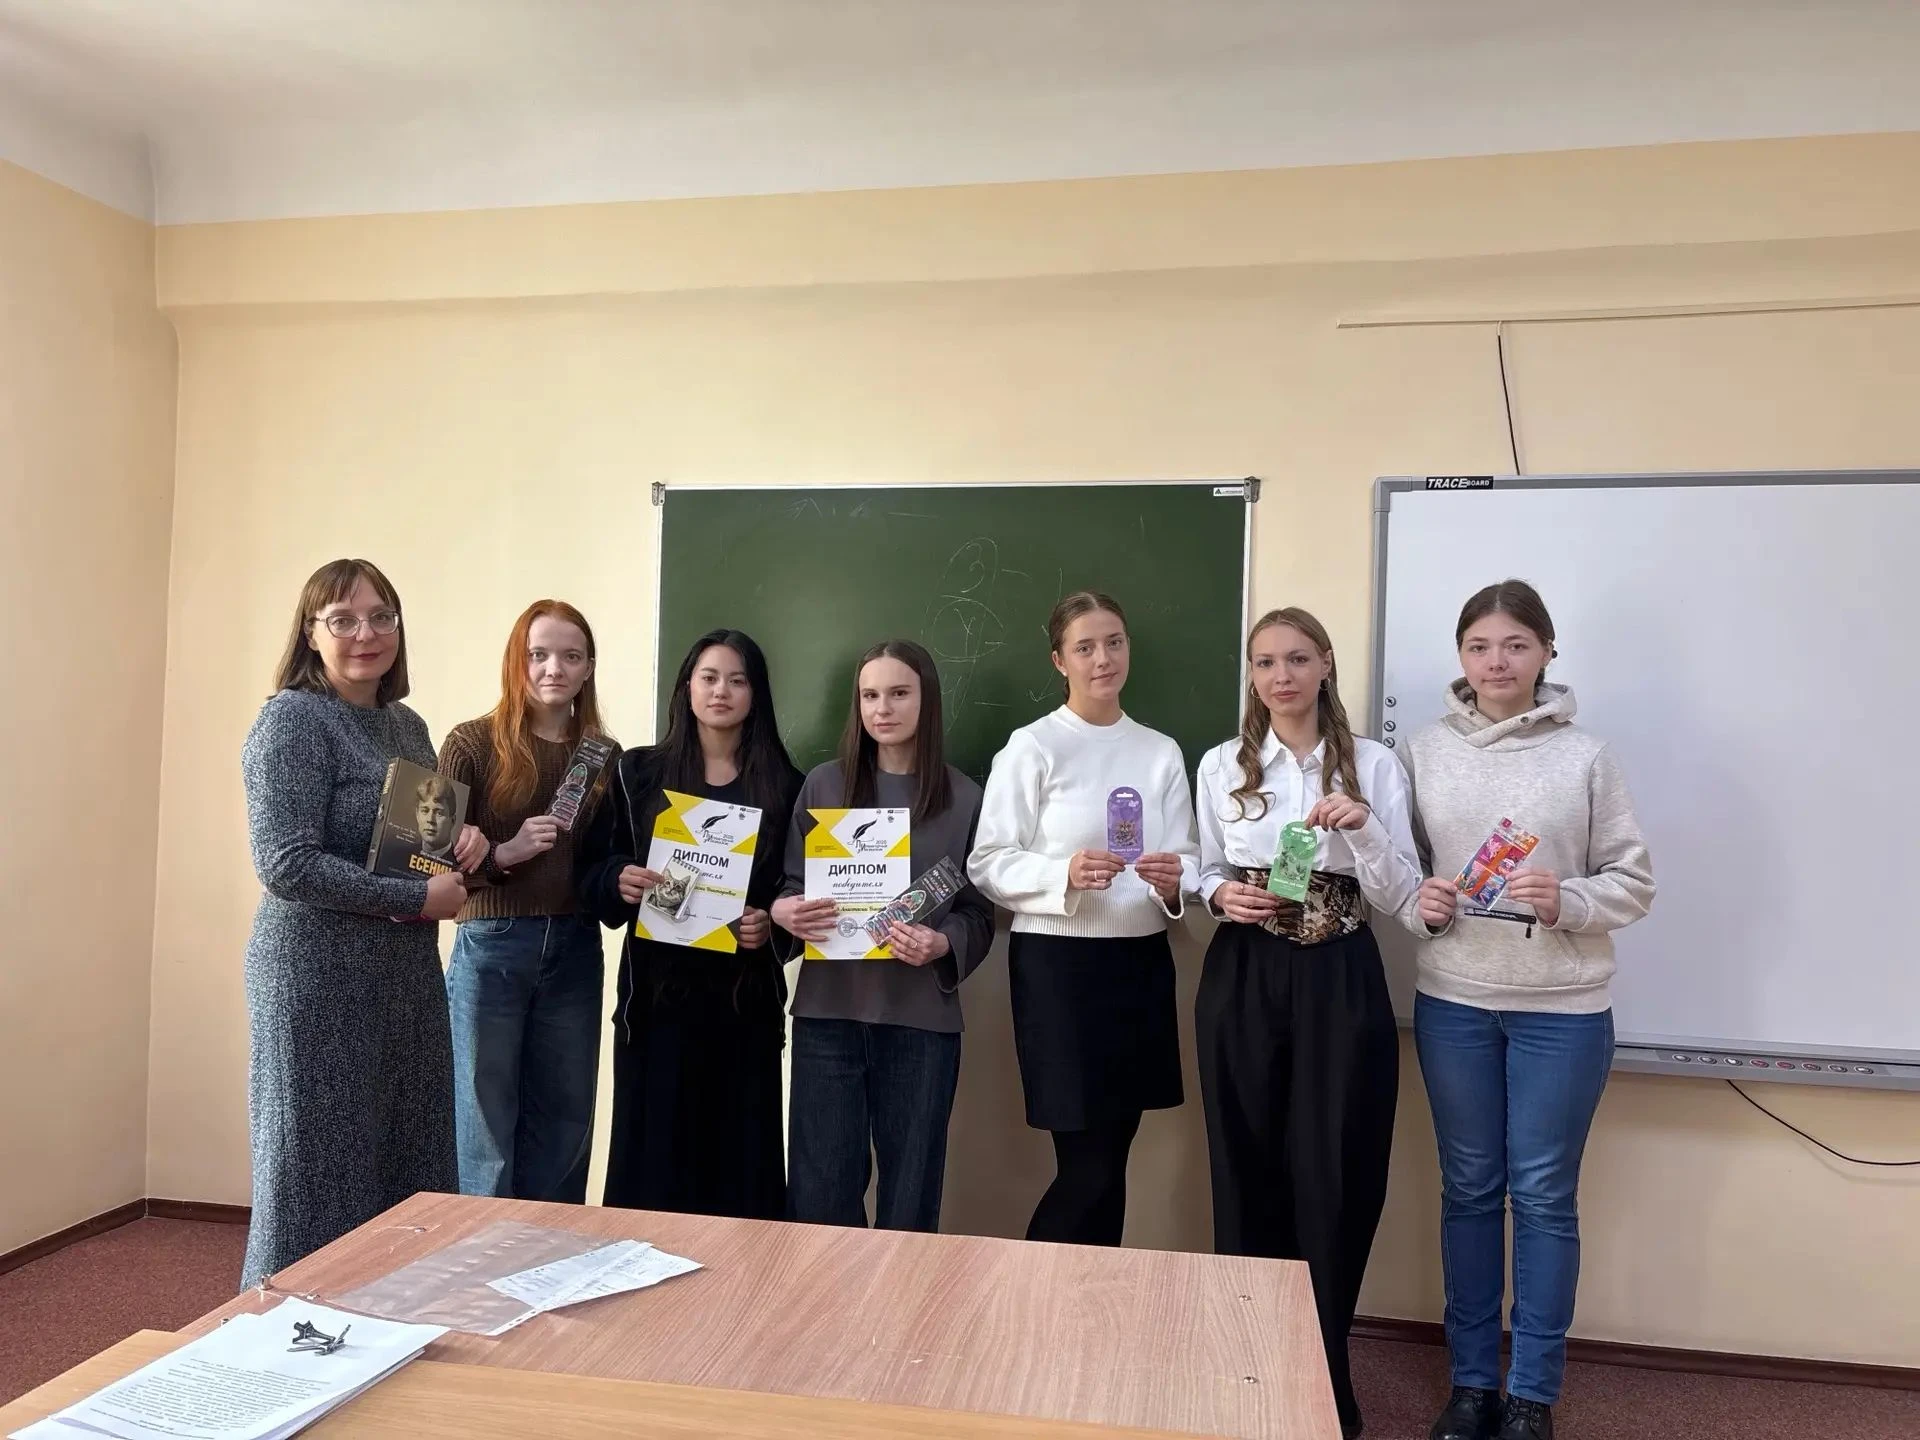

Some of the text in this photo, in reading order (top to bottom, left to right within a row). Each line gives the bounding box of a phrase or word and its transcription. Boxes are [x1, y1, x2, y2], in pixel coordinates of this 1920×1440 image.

[672, 848, 730, 869] ДИПЛОМ
[828, 864, 887, 877] ДИПЛОМ
[832, 878, 884, 891] победителя
